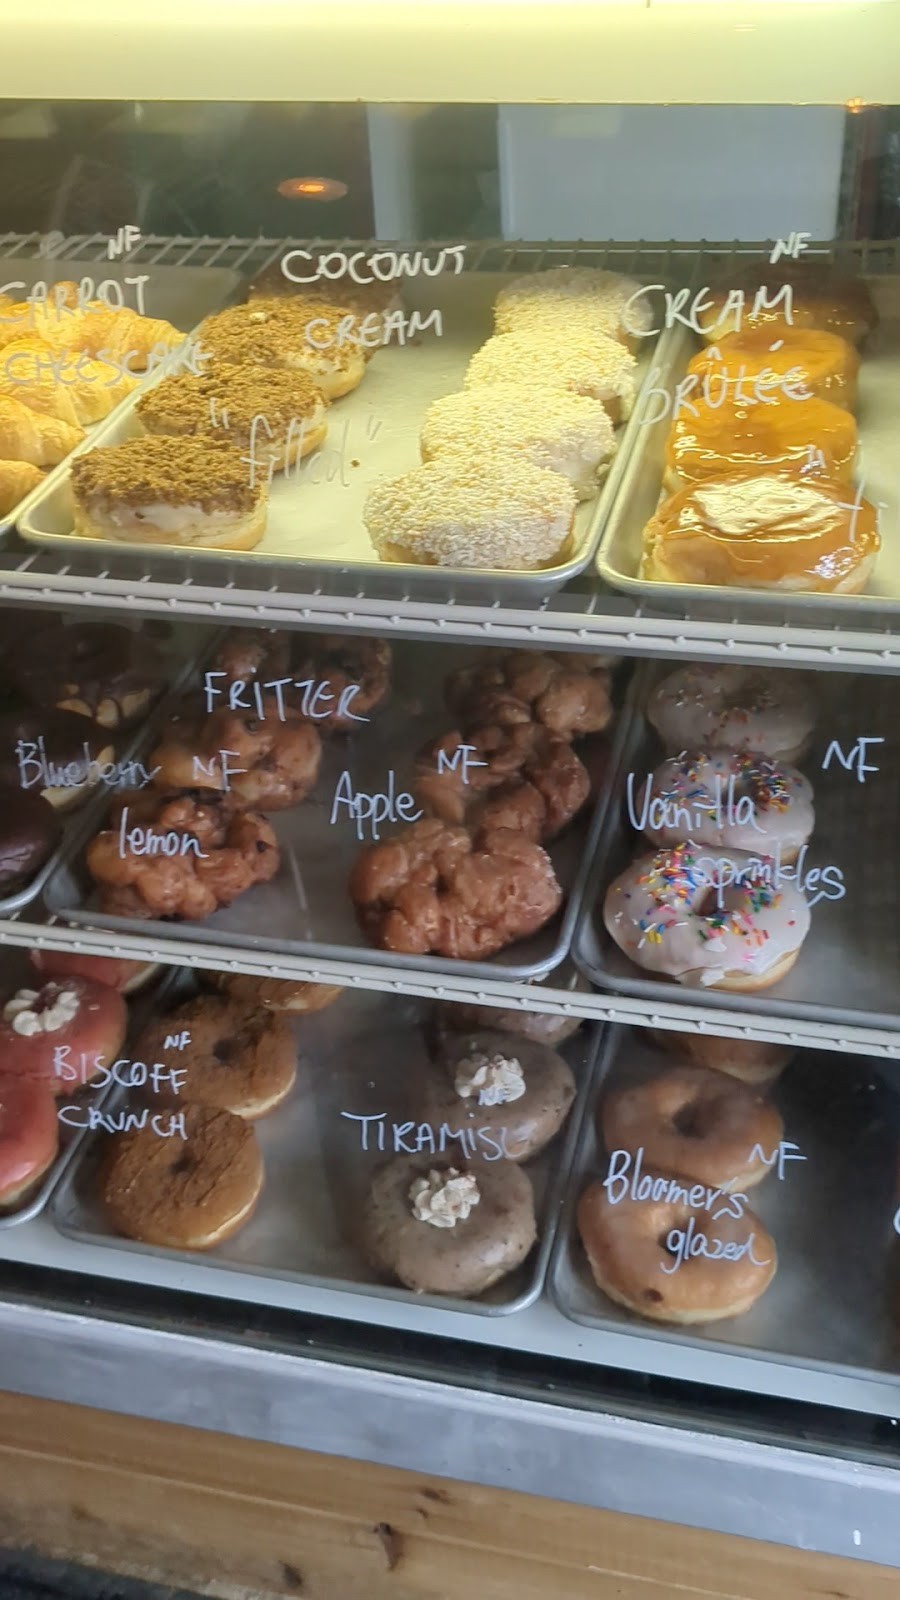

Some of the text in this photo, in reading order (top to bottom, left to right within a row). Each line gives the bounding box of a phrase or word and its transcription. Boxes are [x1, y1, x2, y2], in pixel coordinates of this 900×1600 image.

[107, 225, 141, 260] NF
[281, 245, 467, 284] COCONUT
[771, 232, 812, 264] NF
[0, 275, 150, 329] CARROT
[622, 284, 794, 337] CREAM
[305, 309, 443, 349] CREAM
[204, 666, 371, 722] FRITTER
[15, 736, 162, 789] Blueberry
[192, 750, 249, 793] NF
[437, 745, 489, 784] NF
[822, 737, 885, 783] NF
[330, 770, 424, 840] Apple
[627, 773, 767, 833] Vanilla
[119, 807, 209, 858] lemon
[164, 1031, 192, 1051] NF
[52, 1046, 188, 1094] BISCOFF
[57, 1105, 188, 1141] CRUNCH
[603, 1147, 749, 1220] Bloomer's
[748, 1141, 808, 1180] NF
[660, 1217, 772, 1274] glazed
